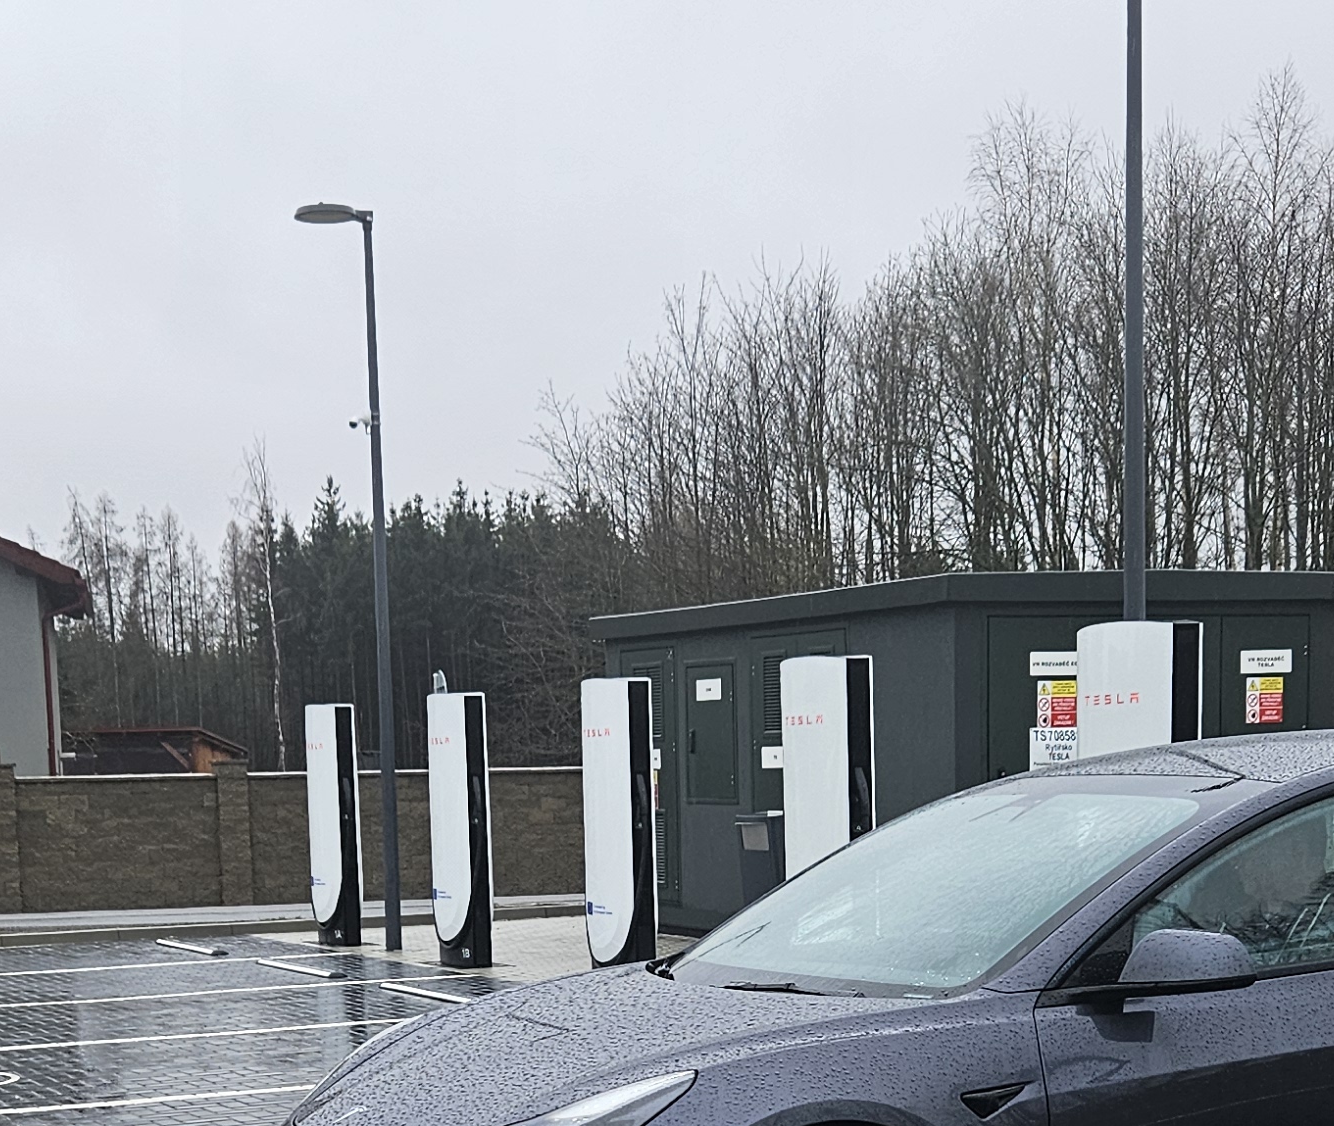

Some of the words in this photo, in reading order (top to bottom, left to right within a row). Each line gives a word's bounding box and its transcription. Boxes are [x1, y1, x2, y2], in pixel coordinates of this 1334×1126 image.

[1084, 692, 1140, 706] TESLA
[785, 714, 823, 726] TESLA
[1033, 730, 1077, 741] TS70858
[1049, 752, 1071, 761] TESLA
